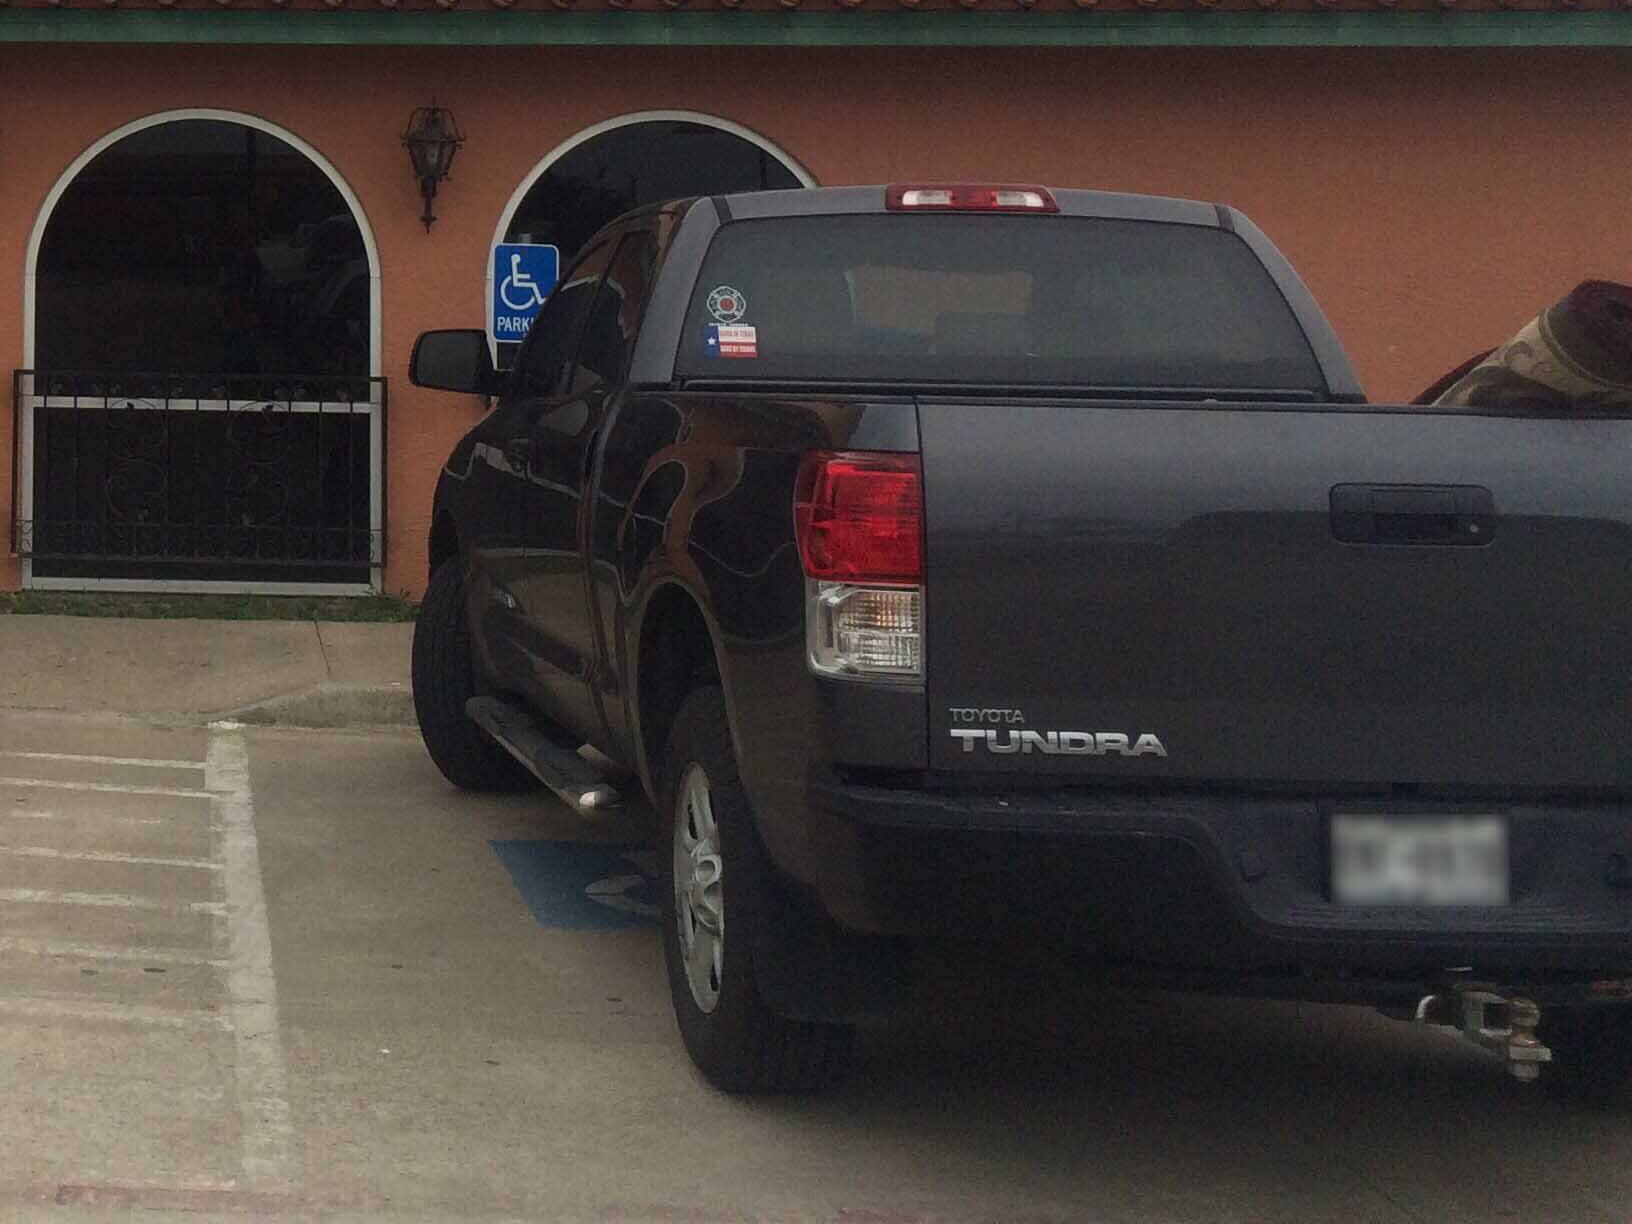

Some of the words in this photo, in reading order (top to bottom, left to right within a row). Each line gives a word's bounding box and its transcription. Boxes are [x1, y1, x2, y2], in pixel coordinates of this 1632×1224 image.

[497, 316, 534, 332] PARK
[949, 707, 1025, 724] TOYOTA
[950, 729, 1168, 757] TUNDRA
